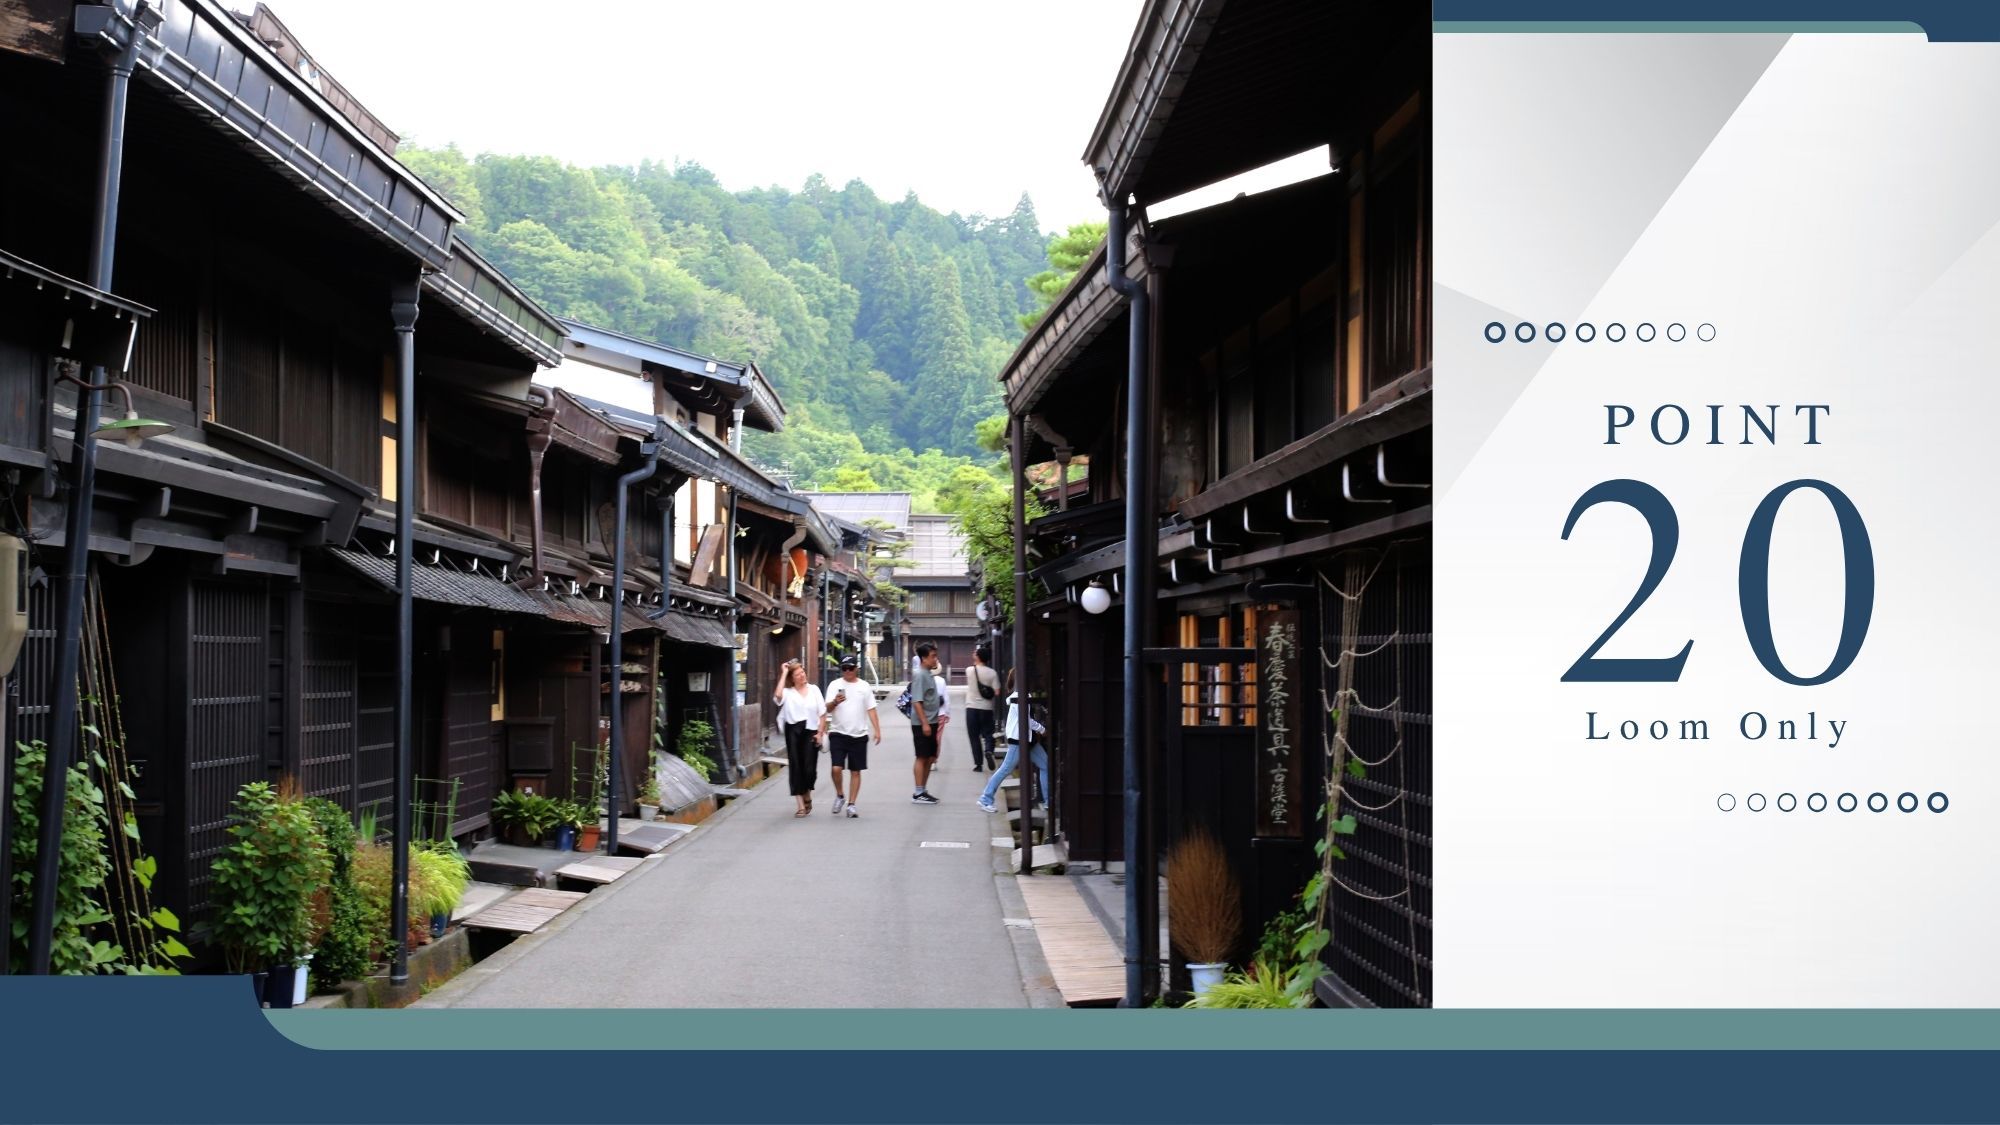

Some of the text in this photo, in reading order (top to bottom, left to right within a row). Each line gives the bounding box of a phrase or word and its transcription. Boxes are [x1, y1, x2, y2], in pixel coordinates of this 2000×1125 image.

[1264, 621, 1291, 757] 春慶茶道具
